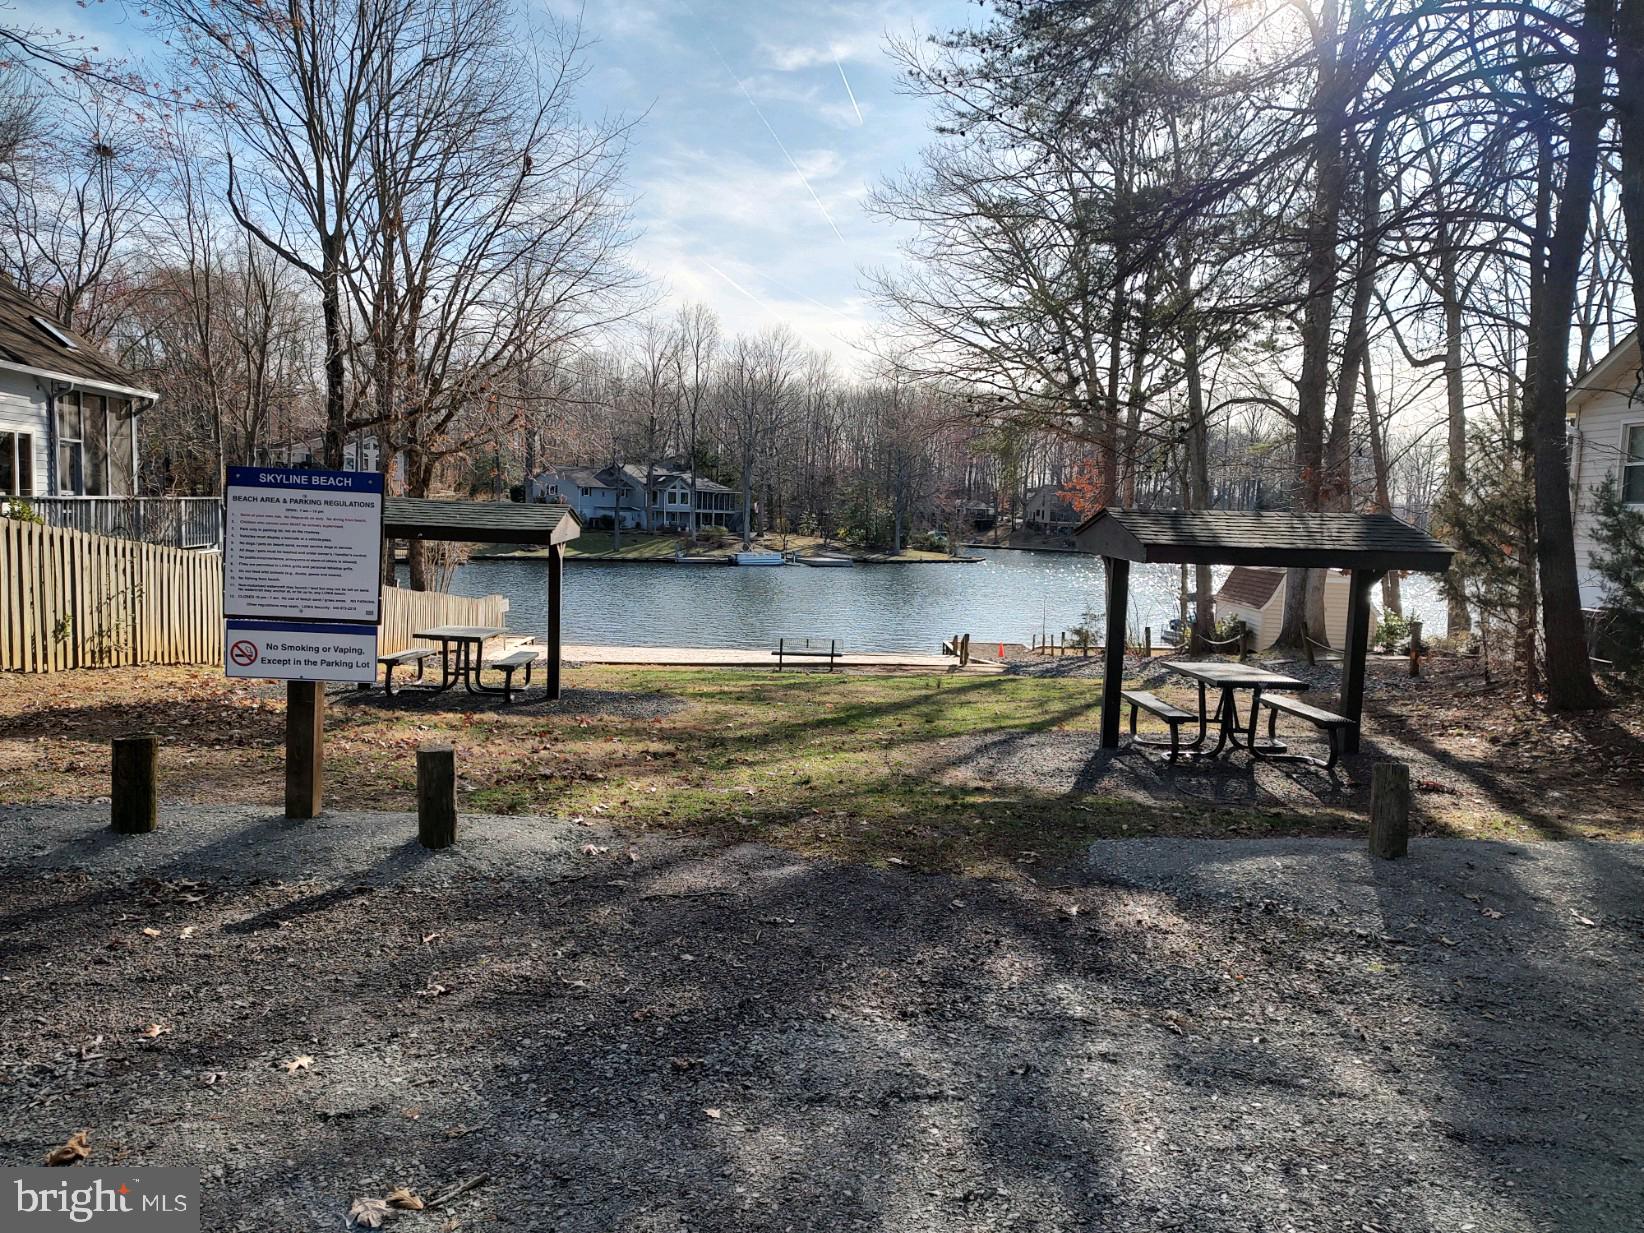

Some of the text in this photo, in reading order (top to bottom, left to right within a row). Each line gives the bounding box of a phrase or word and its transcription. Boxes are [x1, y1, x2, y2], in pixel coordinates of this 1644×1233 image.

[259, 473, 352, 487] SKYLINE BEACH
[289, 498, 322, 506] PARKING
[324, 500, 375, 508] REGULATIONS
[265, 643, 279, 651] No
[281, 643, 320, 654] Smoking
[333, 645, 365, 655] Vaping,
[260, 656, 370, 669] Except in the Parking Lot
